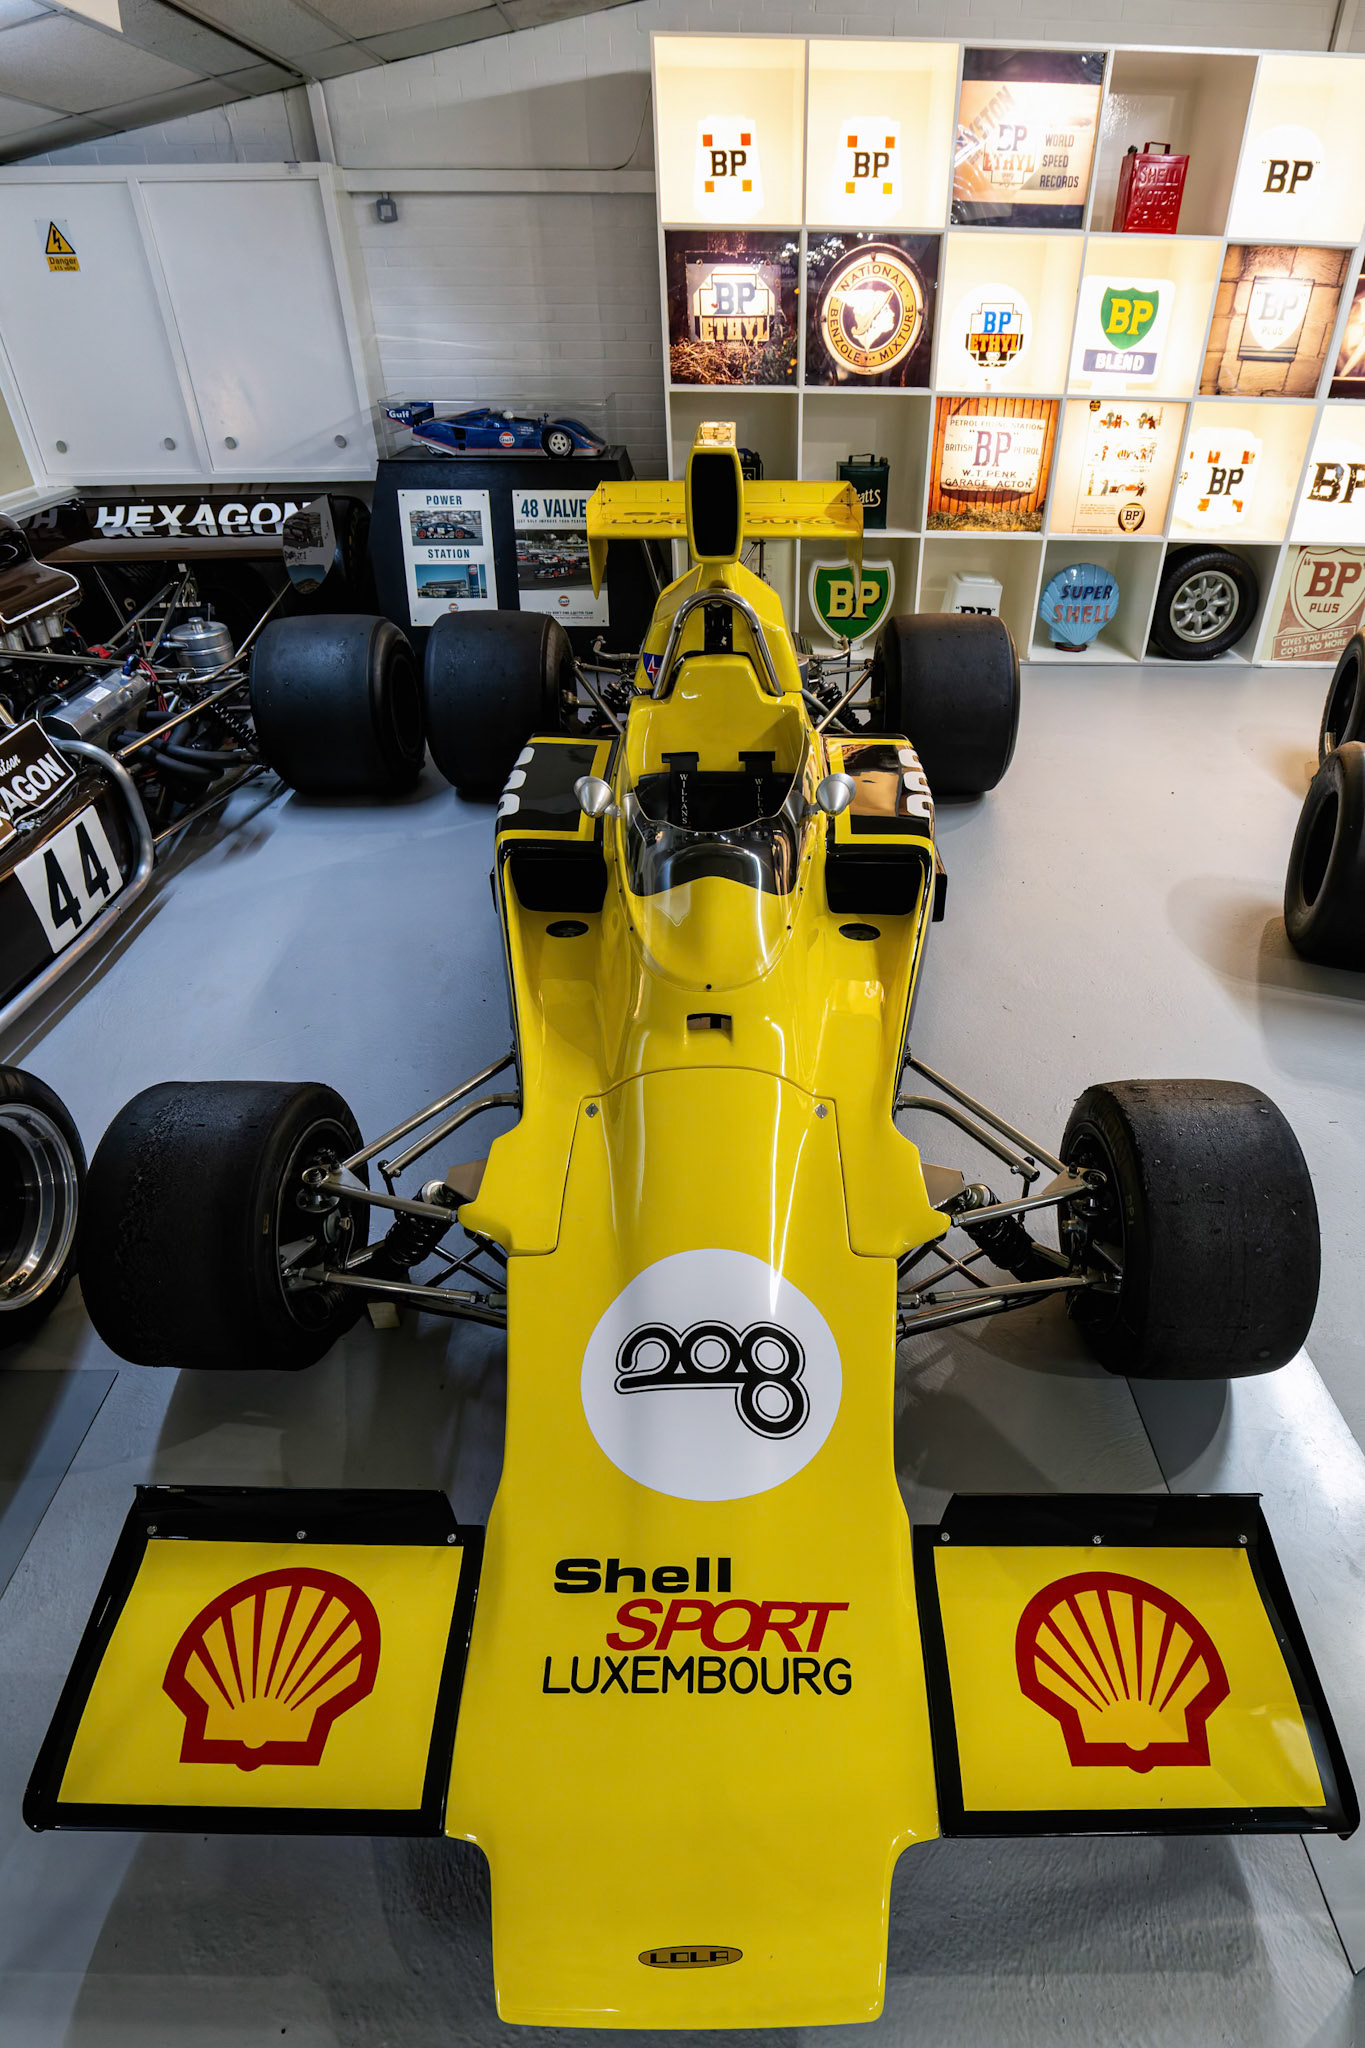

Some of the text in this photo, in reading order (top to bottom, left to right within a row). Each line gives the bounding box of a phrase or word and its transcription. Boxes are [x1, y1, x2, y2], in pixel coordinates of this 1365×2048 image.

[1045, 134, 1075, 147] WORLD
[709, 150, 747, 177] BP
[853, 152, 890, 178] BP
[1042, 155, 1069, 168] SPEED
[1040, 175, 1080, 188] RECORDS
[1139, 166, 1178, 187] SHELL
[49, 256, 76, 265] Danger
[840, 264, 906, 292] NATIONAL
[713, 282, 756, 315] BP
[982, 311, 1012, 334] BP
[1105, 298, 1154, 335] BP
[702, 317, 768, 341] ETHYL
[830, 308, 862, 363] BENZOLE
[879, 304, 914, 361] MIXTURE
[970, 334, 1018, 352] ETHYL
[1095, 352, 1145, 371] BLEND
[389, 408, 410, 418] Gulf
[950, 419, 977, 427] PETROL
[1012, 422, 1042, 430] STATION
[945, 443, 973, 452] BRITISH
[945, 478, 1031, 489] GARAGE ACTON
[986, 470, 1017, 479] PENK
[1206, 467, 1244, 495] BP
[425, 495, 463, 505] POWER
[521, 499, 539, 518] 48
[427, 548, 471, 559] STATION
[826, 580, 882, 620] BP
[1061, 585, 1113, 600] SUPER
[1052, 604, 1111, 623] SHELL
[1309, 603, 1340, 613] PLUS
[1281, 637, 1302, 647] GIVES
[1304, 634, 1320, 643] YOU
[1281, 638, 1347, 655] COSTS NO MORE
[680, 773, 689, 824] WILLANS
[43, 821, 111, 929] 44
[613, 1320, 810, 1440] 208
[553, 1557, 731, 1594] Shell
[605, 1598, 850, 1653] SPORT
[542, 1655, 852, 1696] LUXEMBOURG
[650, 1950, 729, 1964] LOLA
